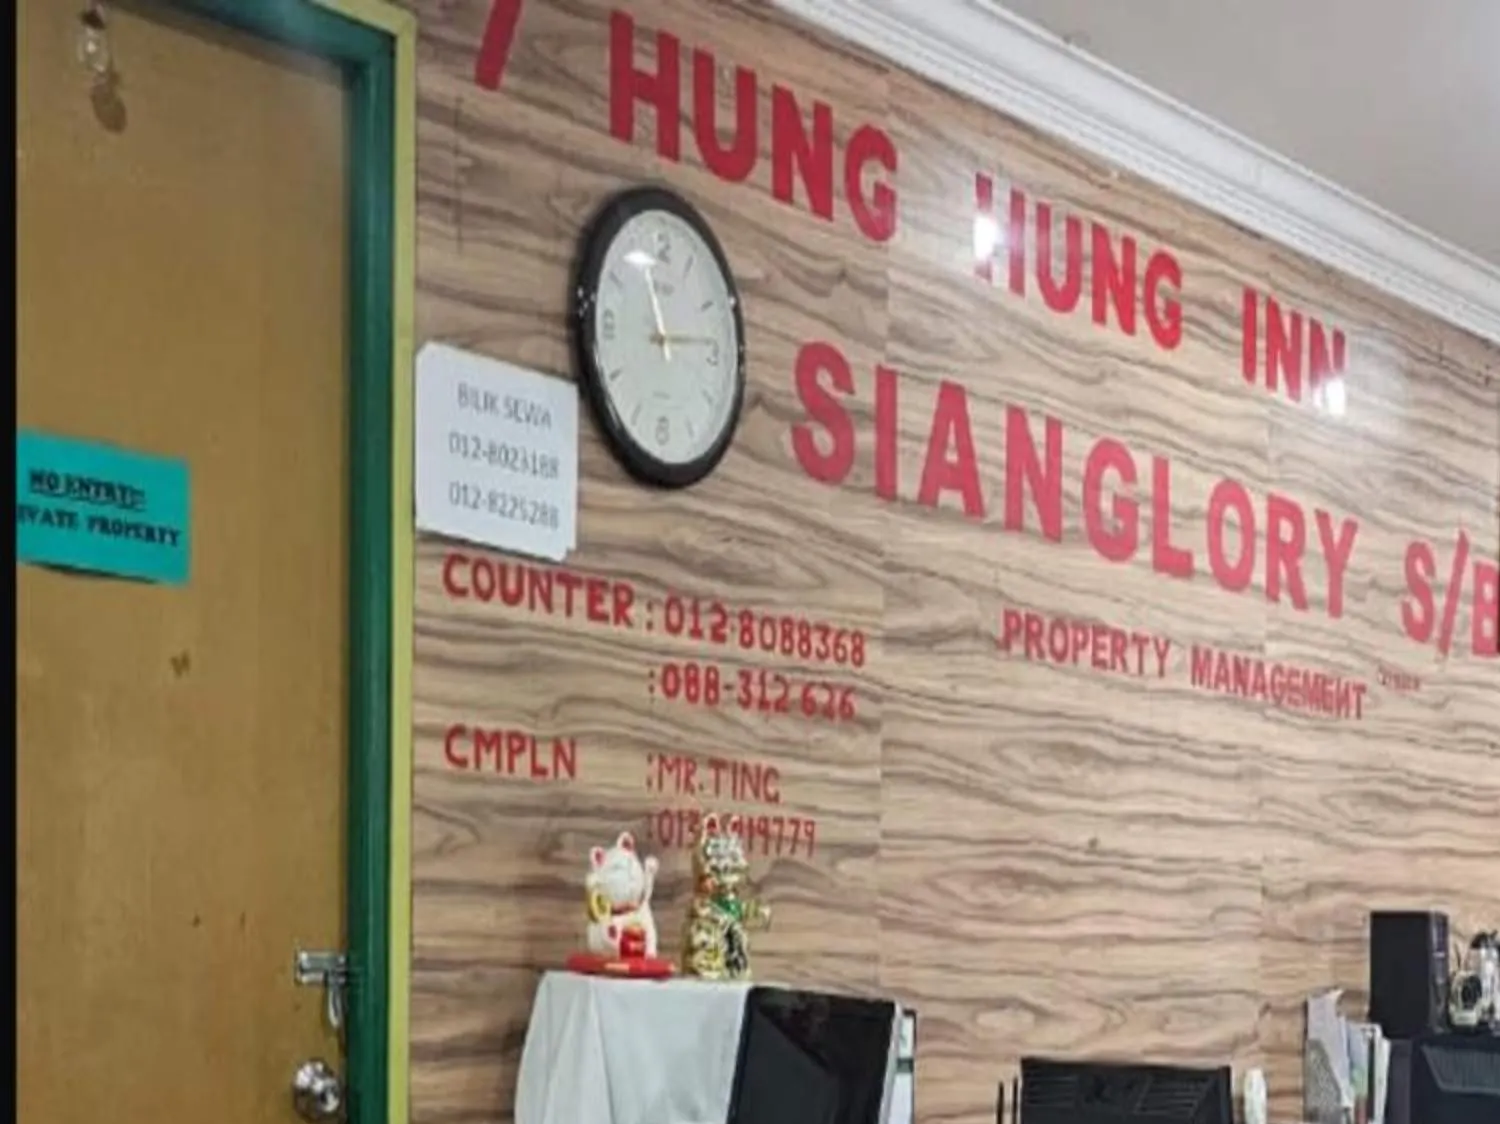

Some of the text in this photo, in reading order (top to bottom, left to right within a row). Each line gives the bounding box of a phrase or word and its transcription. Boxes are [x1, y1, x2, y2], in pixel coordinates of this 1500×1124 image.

[609, 9, 897, 243] HUNG
[974, 171, 1182, 350] HUNG
[1241, 285, 1345, 415] INN
[30, 468, 61, 497] NO
[790, 340, 1359, 620] SIANGLORY
[86, 513, 182, 547] PROPERTY
[442, 553, 634, 628] COUNTER
[1001, 607, 1366, 720] PROPERTY MANAGEMENT
[445, 723, 577, 780] CMPLN
